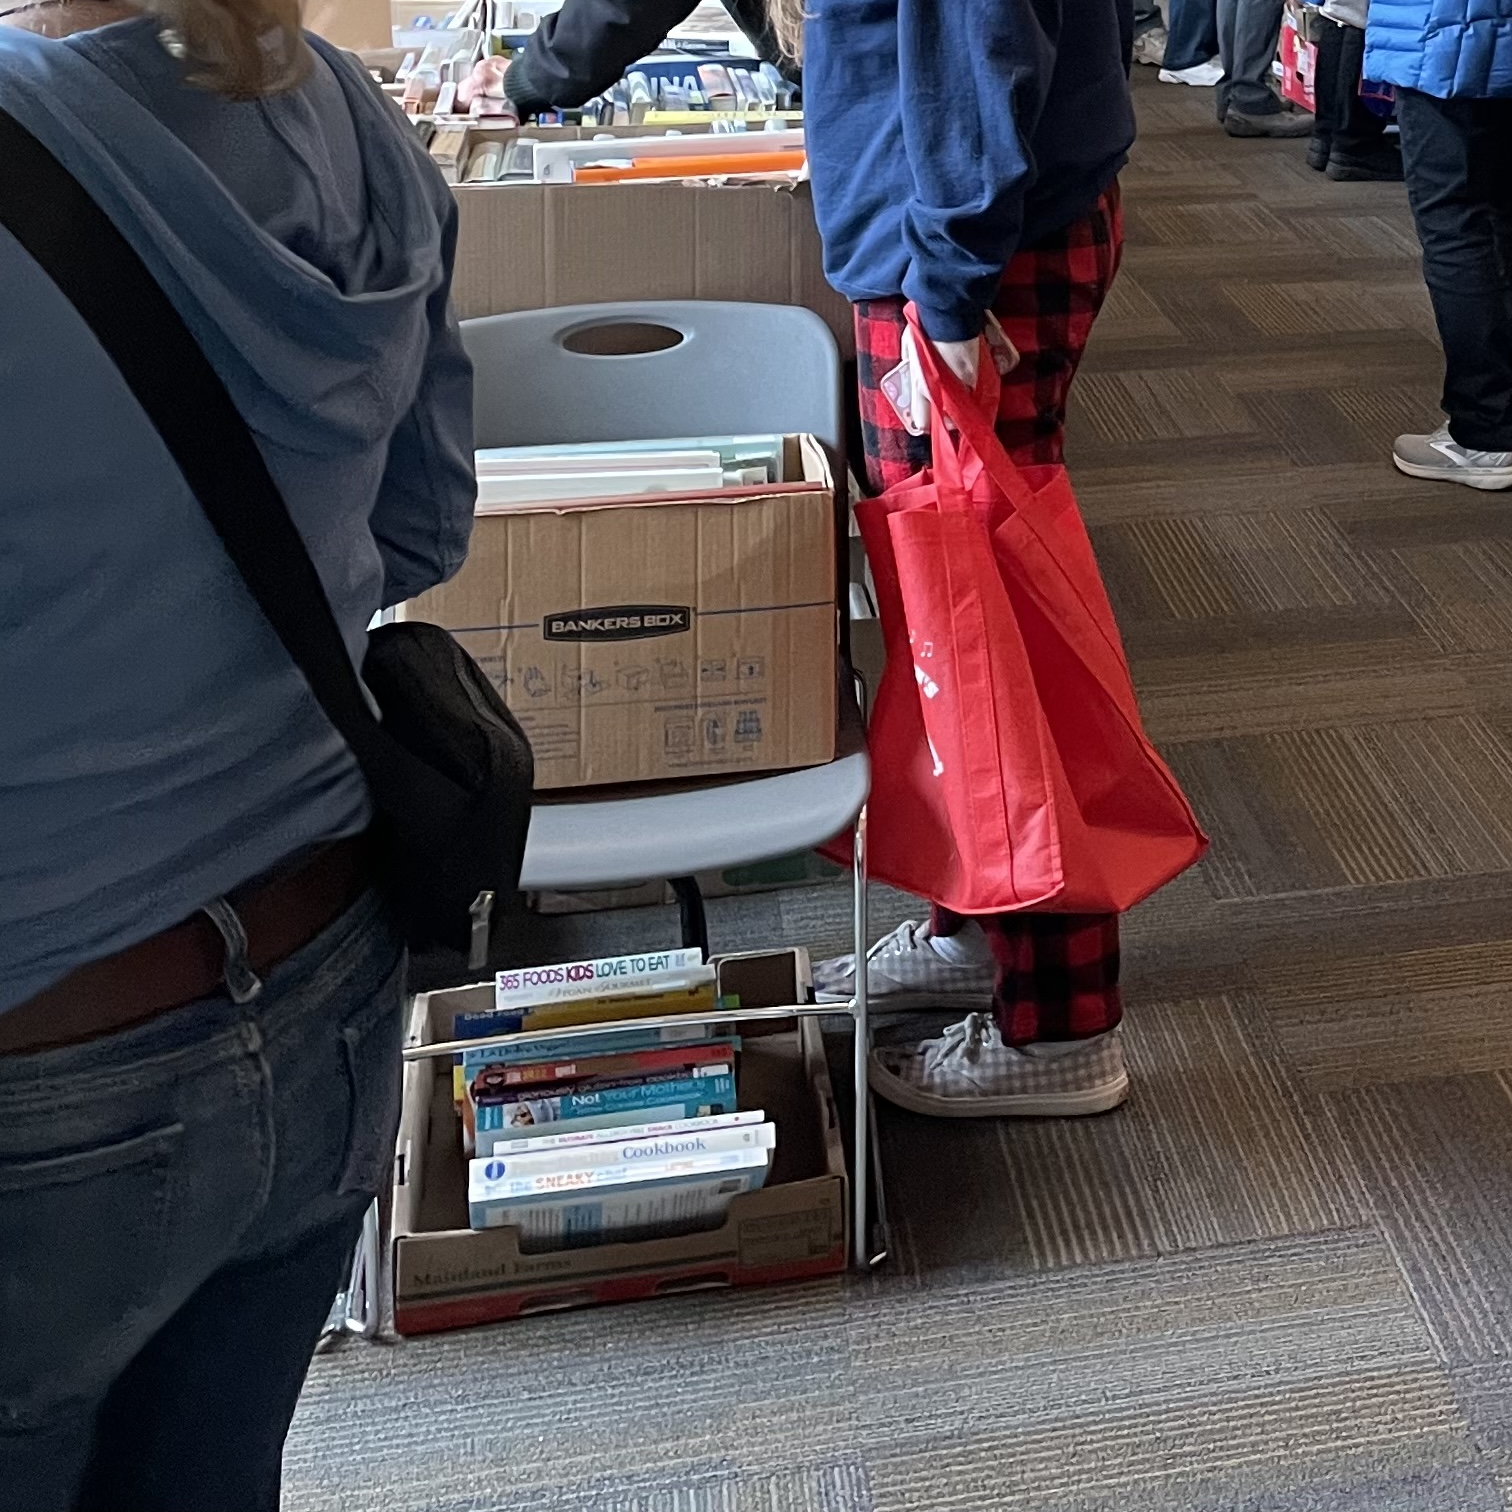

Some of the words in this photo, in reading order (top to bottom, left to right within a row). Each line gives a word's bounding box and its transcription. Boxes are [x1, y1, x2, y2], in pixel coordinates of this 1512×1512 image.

[551, 616, 641, 633] BANKERS
[643, 612, 684, 628] BOX
[499, 974, 520, 991] 365
[523, 967, 564, 988] FOODS
[566, 963, 594, 983] KIDS
[595, 960, 627, 978] LOVE
[630, 957, 646, 973] TO
[648, 954, 670, 971] EAT
[571, 1093, 600, 1107] Not
[604, 1088, 636, 1101] Your
[641, 1078, 706, 1097] Mother's
[622, 1138, 706, 1160] Cookbook
[535, 1171, 594, 1190] SNEAKY
